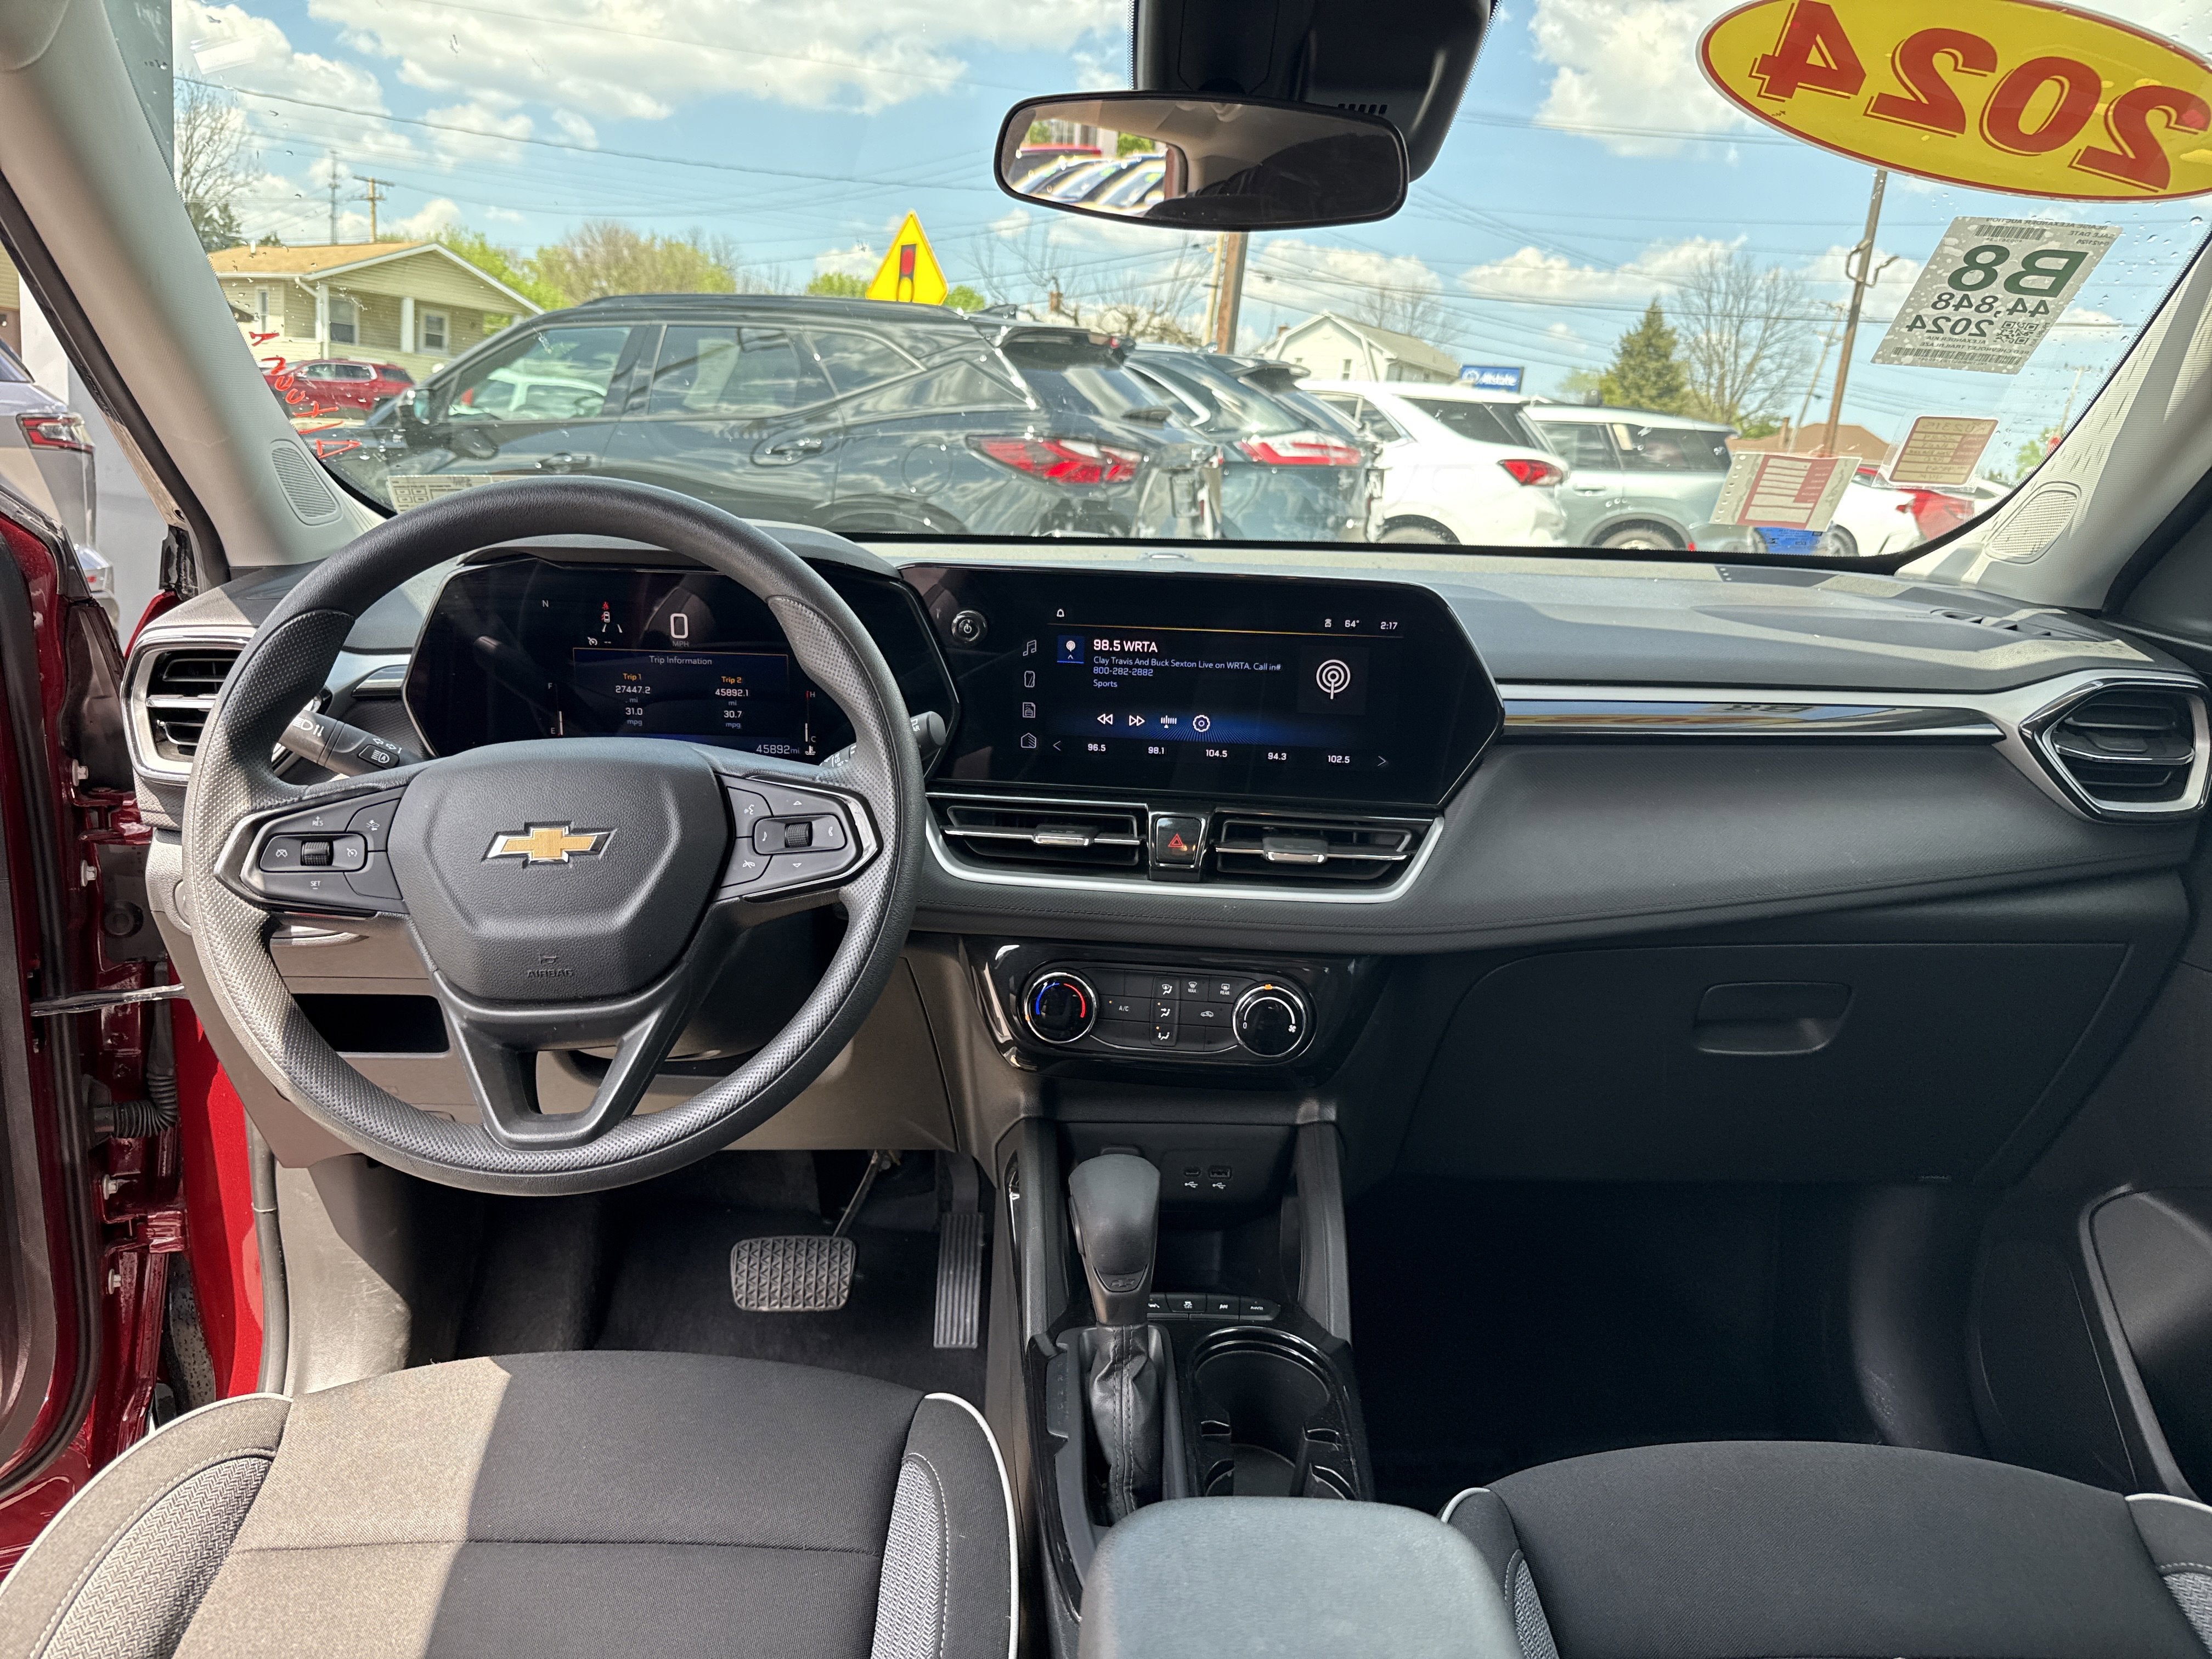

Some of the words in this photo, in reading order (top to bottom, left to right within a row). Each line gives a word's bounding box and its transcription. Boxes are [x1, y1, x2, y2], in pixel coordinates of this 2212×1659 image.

[1094, 640, 1120, 651] 98.5
[1124, 641, 1158, 652] WRTA
[650, 656, 664, 665] Trip
[667, 656, 713, 665] Information
[1094, 657, 1108, 665] Clay
[1093, 667, 1154, 676] 800-282-2882
[1093, 680, 1118, 688] Sports
[616, 686, 651, 694] 27447.2
[715, 689, 749, 697] 45892.1
[1206, 749, 1227, 758] 104.5
[1328, 755, 1350, 764] 102.5
